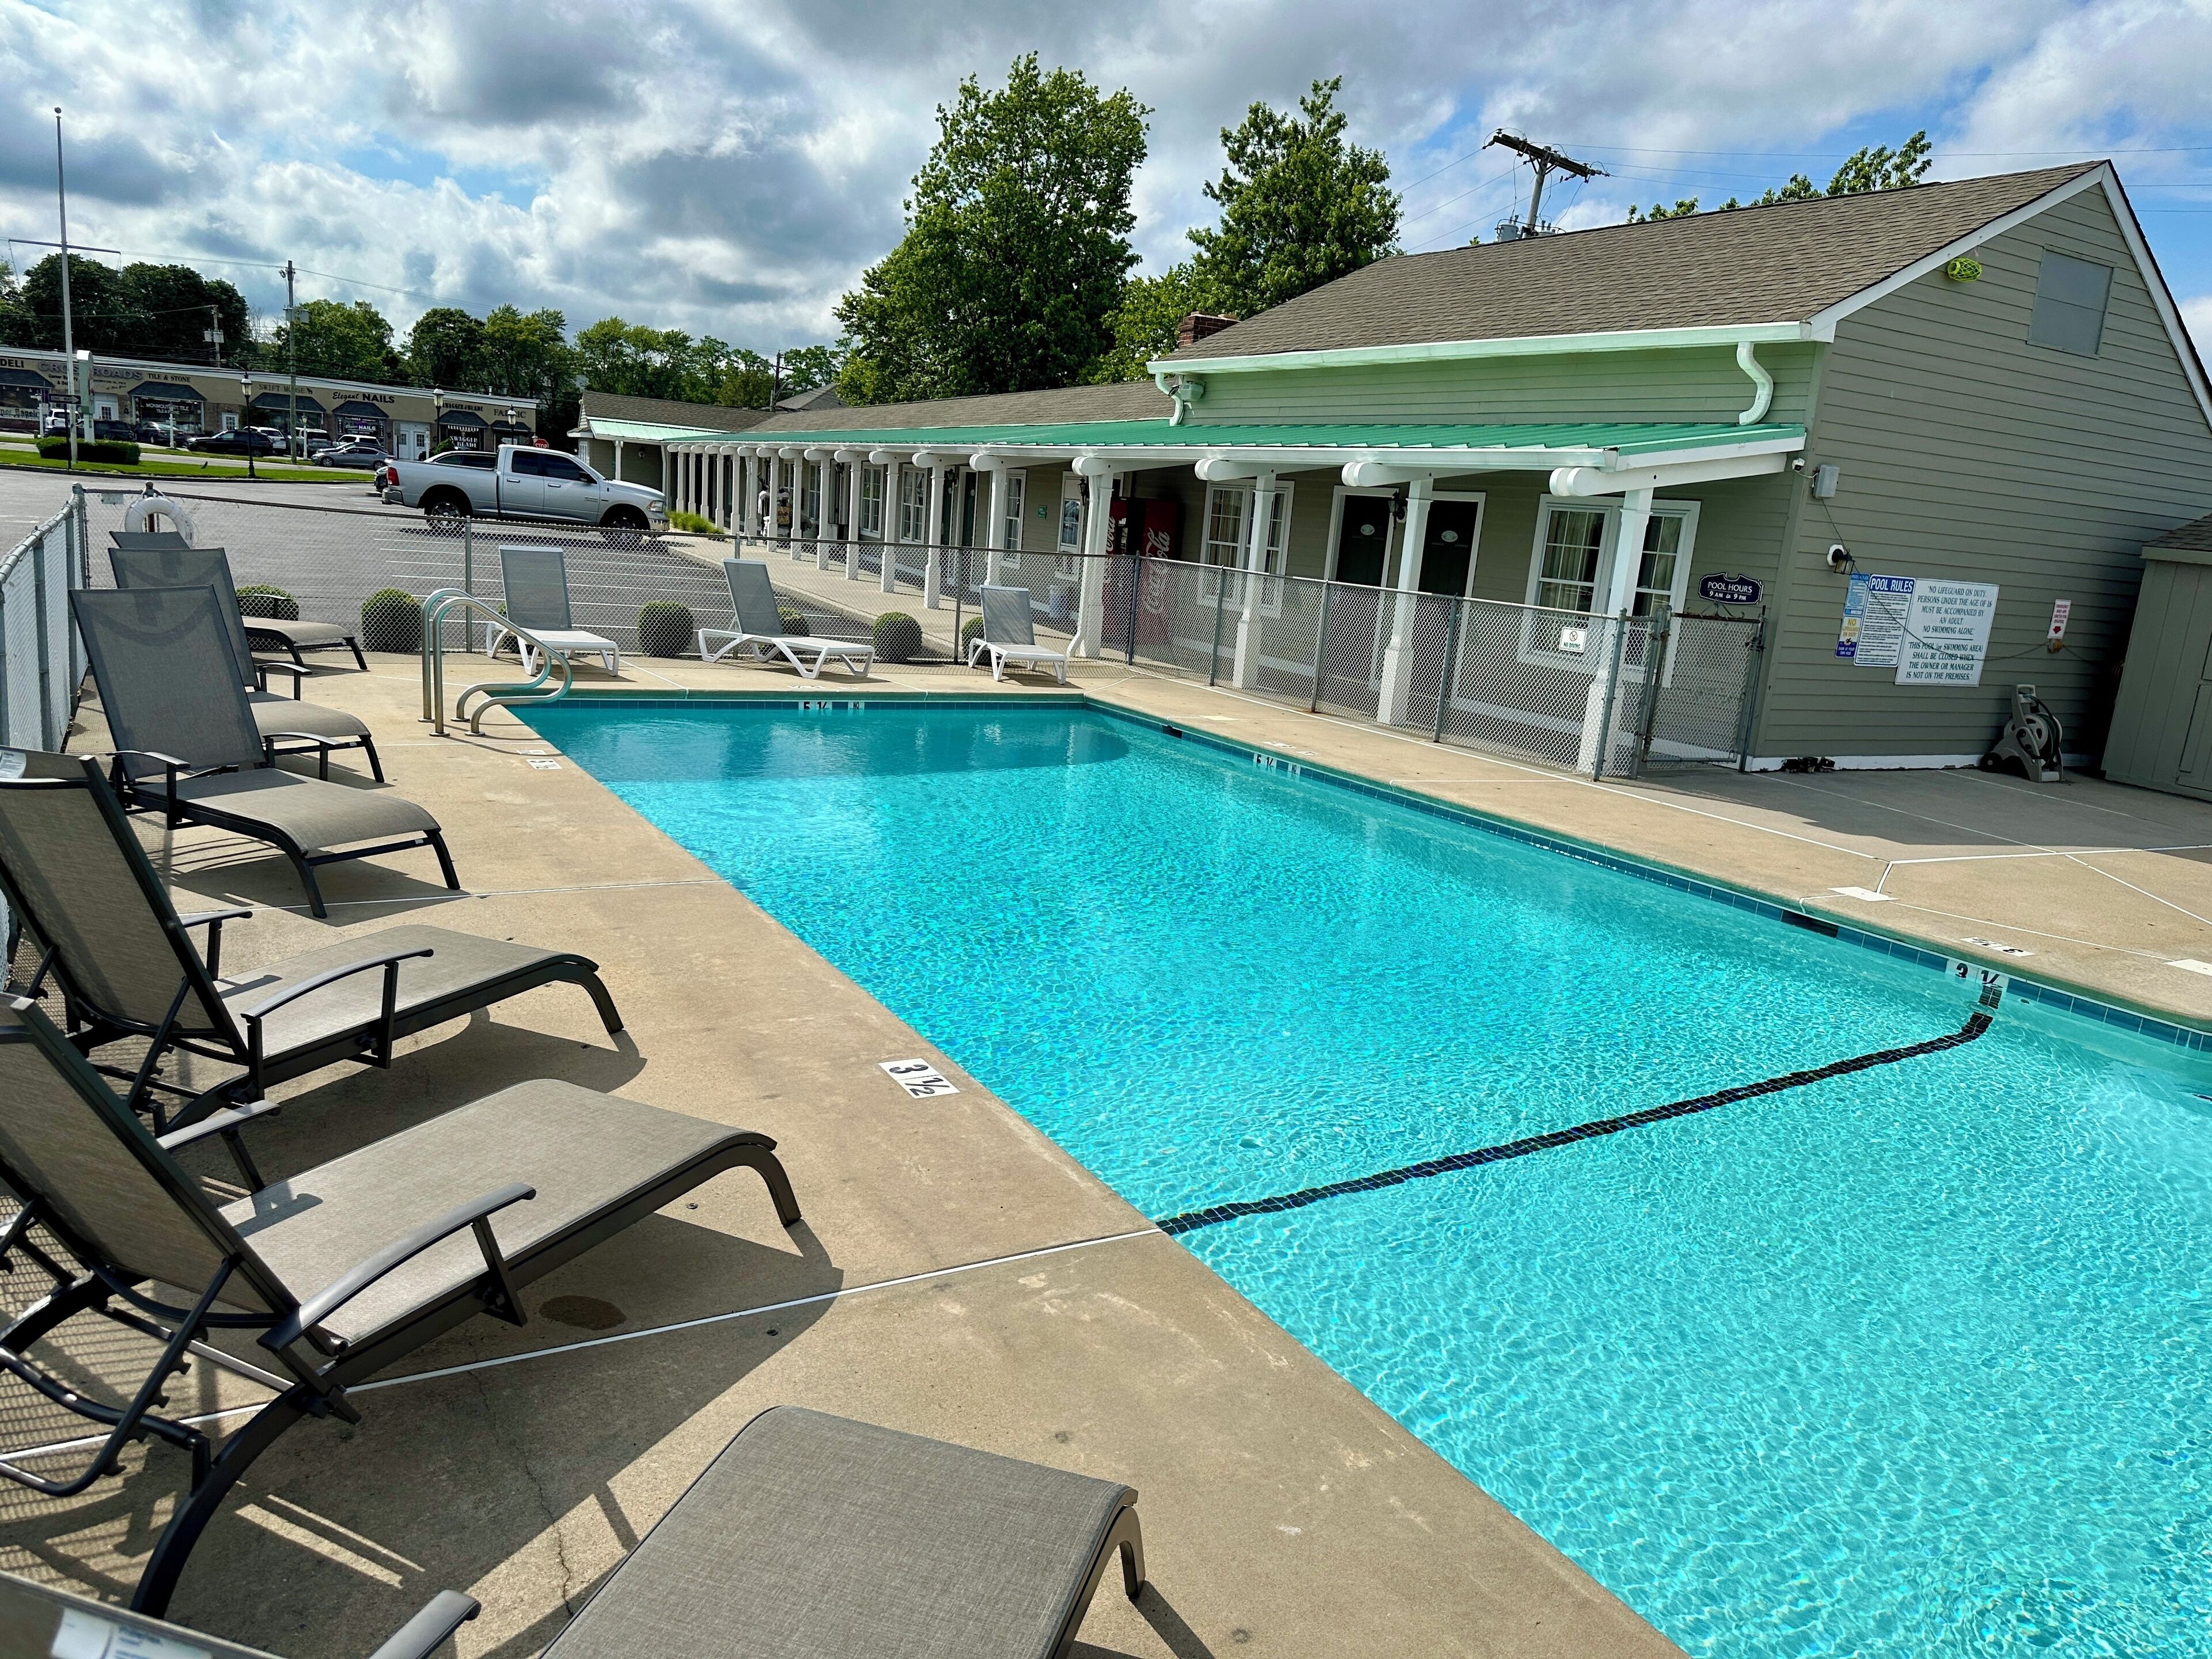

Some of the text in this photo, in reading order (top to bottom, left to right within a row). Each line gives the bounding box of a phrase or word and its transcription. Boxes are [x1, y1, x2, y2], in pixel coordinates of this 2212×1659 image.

[0, 359, 24, 368] DELI
[39, 361, 143, 380] CROSROADS
[259, 384, 305, 394] SWIFT MOSE
[332, 391, 395, 403] Elegant NAILS
[1708, 582, 1752, 593] POOL HOURS
[1870, 578, 1913, 592] POOL RULES
[1938, 586, 1964, 596] LIFEGUARD
[1917, 595, 1940, 604] PERSONS
[1941, 597, 1957, 605] UNDER
[1921, 605, 1935, 613] MUST
[1943, 607, 1977, 616] ACCOMPANIED
[1848, 618, 1857, 626] NO
[1931, 626, 1957, 634] SWIMMING
[1944, 643, 1968, 652] SWIMMING
[889, 1064, 929, 1074] 3
